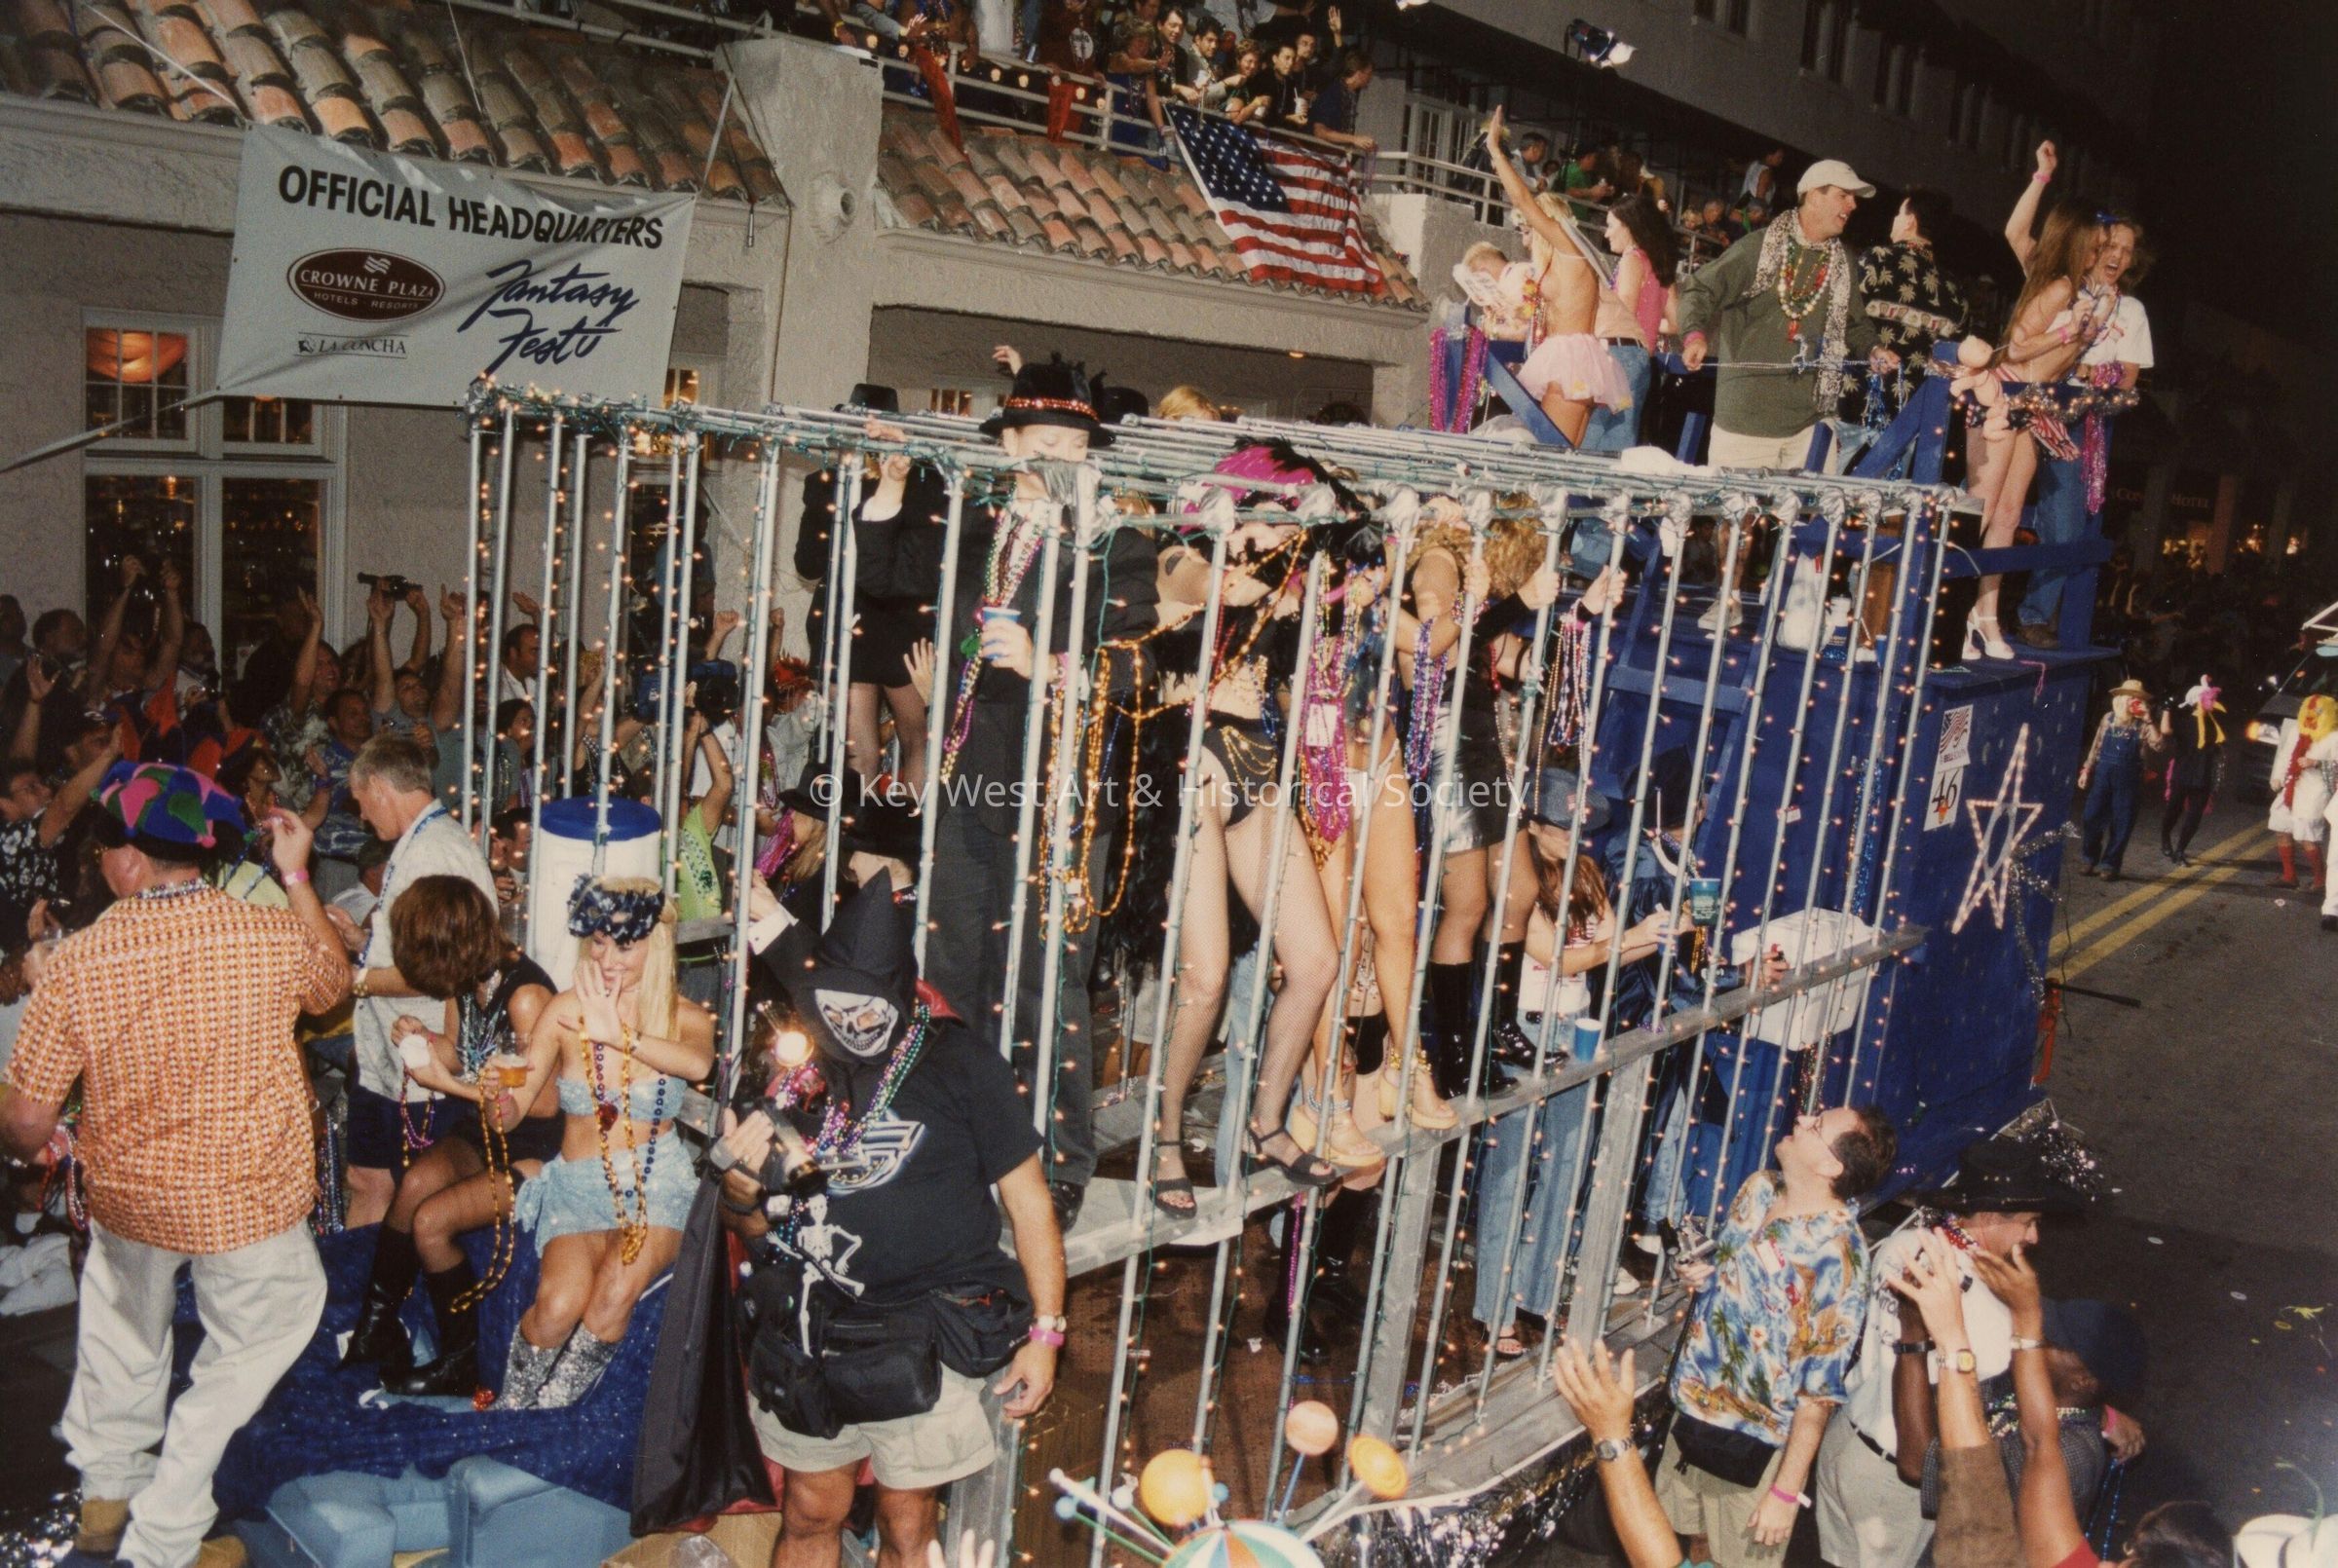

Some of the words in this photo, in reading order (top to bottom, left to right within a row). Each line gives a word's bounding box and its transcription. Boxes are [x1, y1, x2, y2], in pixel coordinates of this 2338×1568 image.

[279, 165, 436, 228] OFFICIAL
[448, 198, 663, 250] HEADQUARTERS
[300, 269, 379, 292] CROWNE
[388, 280, 434, 298] PLAZA
[314, 292, 359, 306] HOTELS
[371, 300, 419, 311] RESORTS
[457, 259, 640, 333] Fantasy
[319, 340, 337, 353] LA
[470, 308, 622, 386] Fest
[1932, 767, 1960, 813] 46
